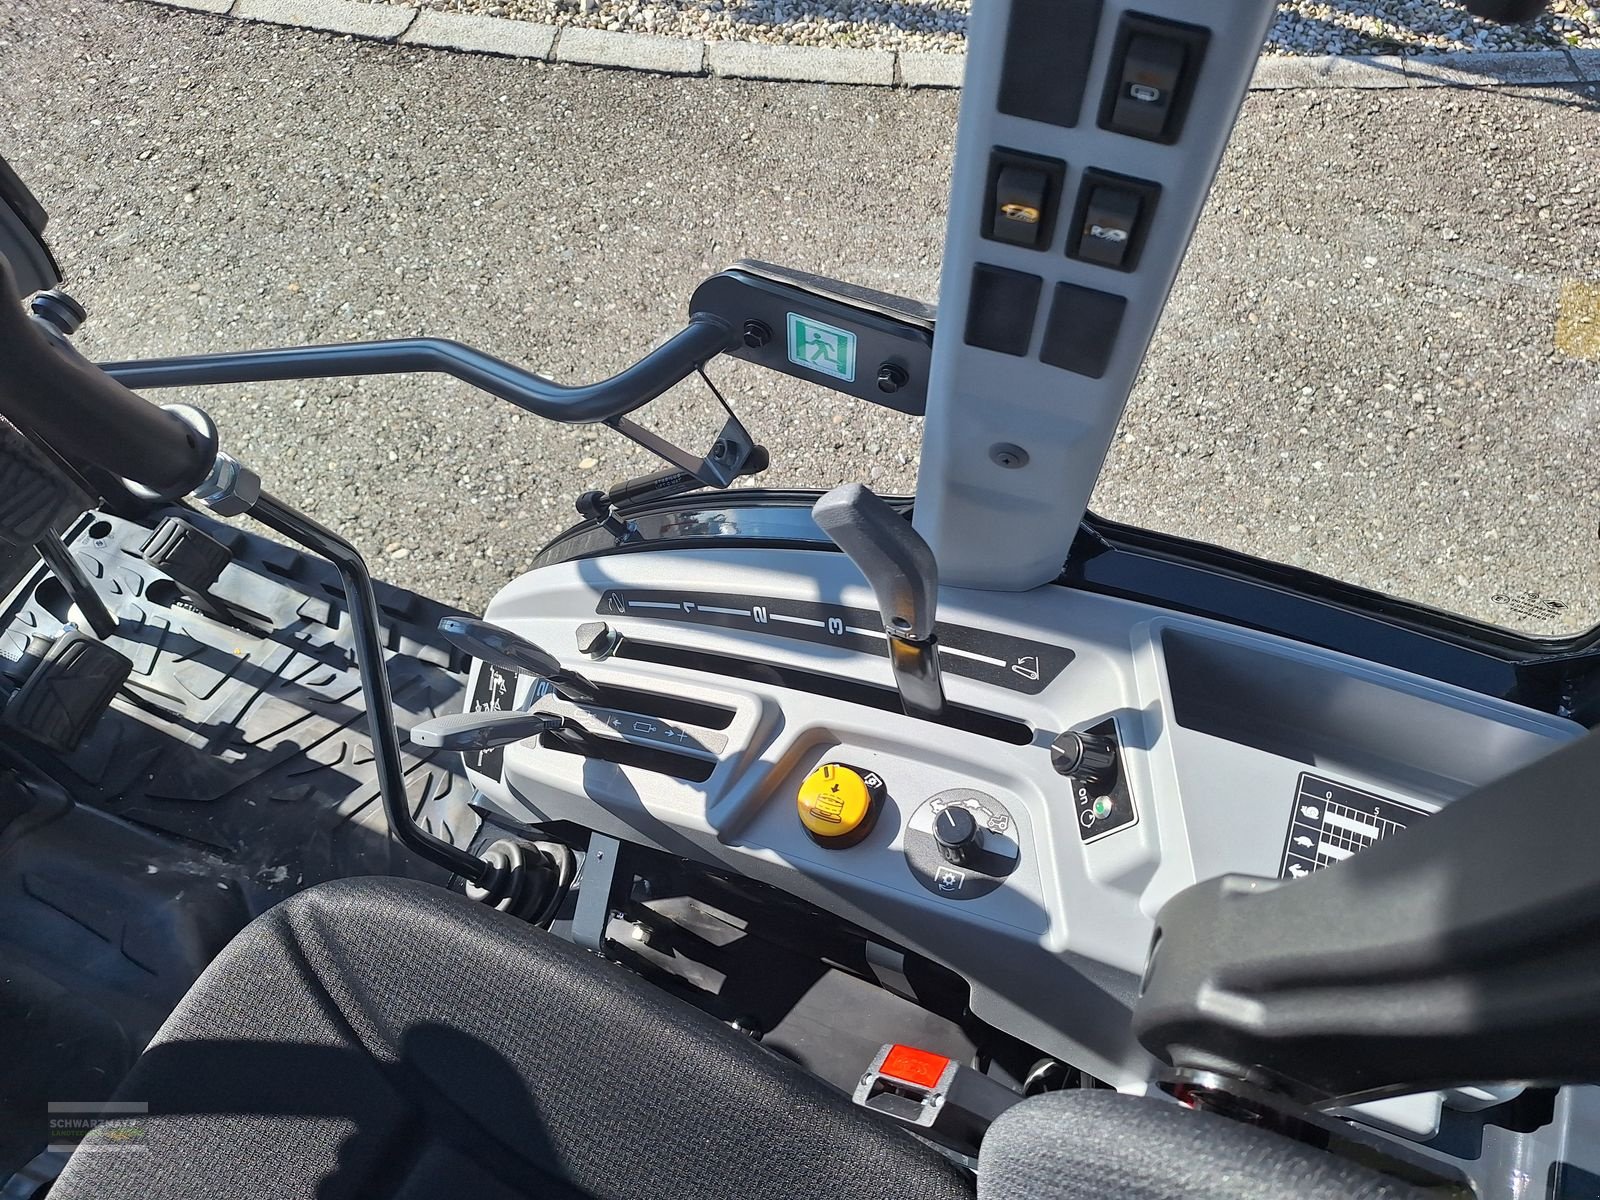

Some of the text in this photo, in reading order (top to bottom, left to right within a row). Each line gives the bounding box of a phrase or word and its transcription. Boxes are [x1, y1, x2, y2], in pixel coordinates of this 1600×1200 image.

[753, 606, 768, 624] 2
[828, 617, 843, 636] 3
[1078, 787, 1088, 805] on
[1325, 791, 1380, 815] 0 5
